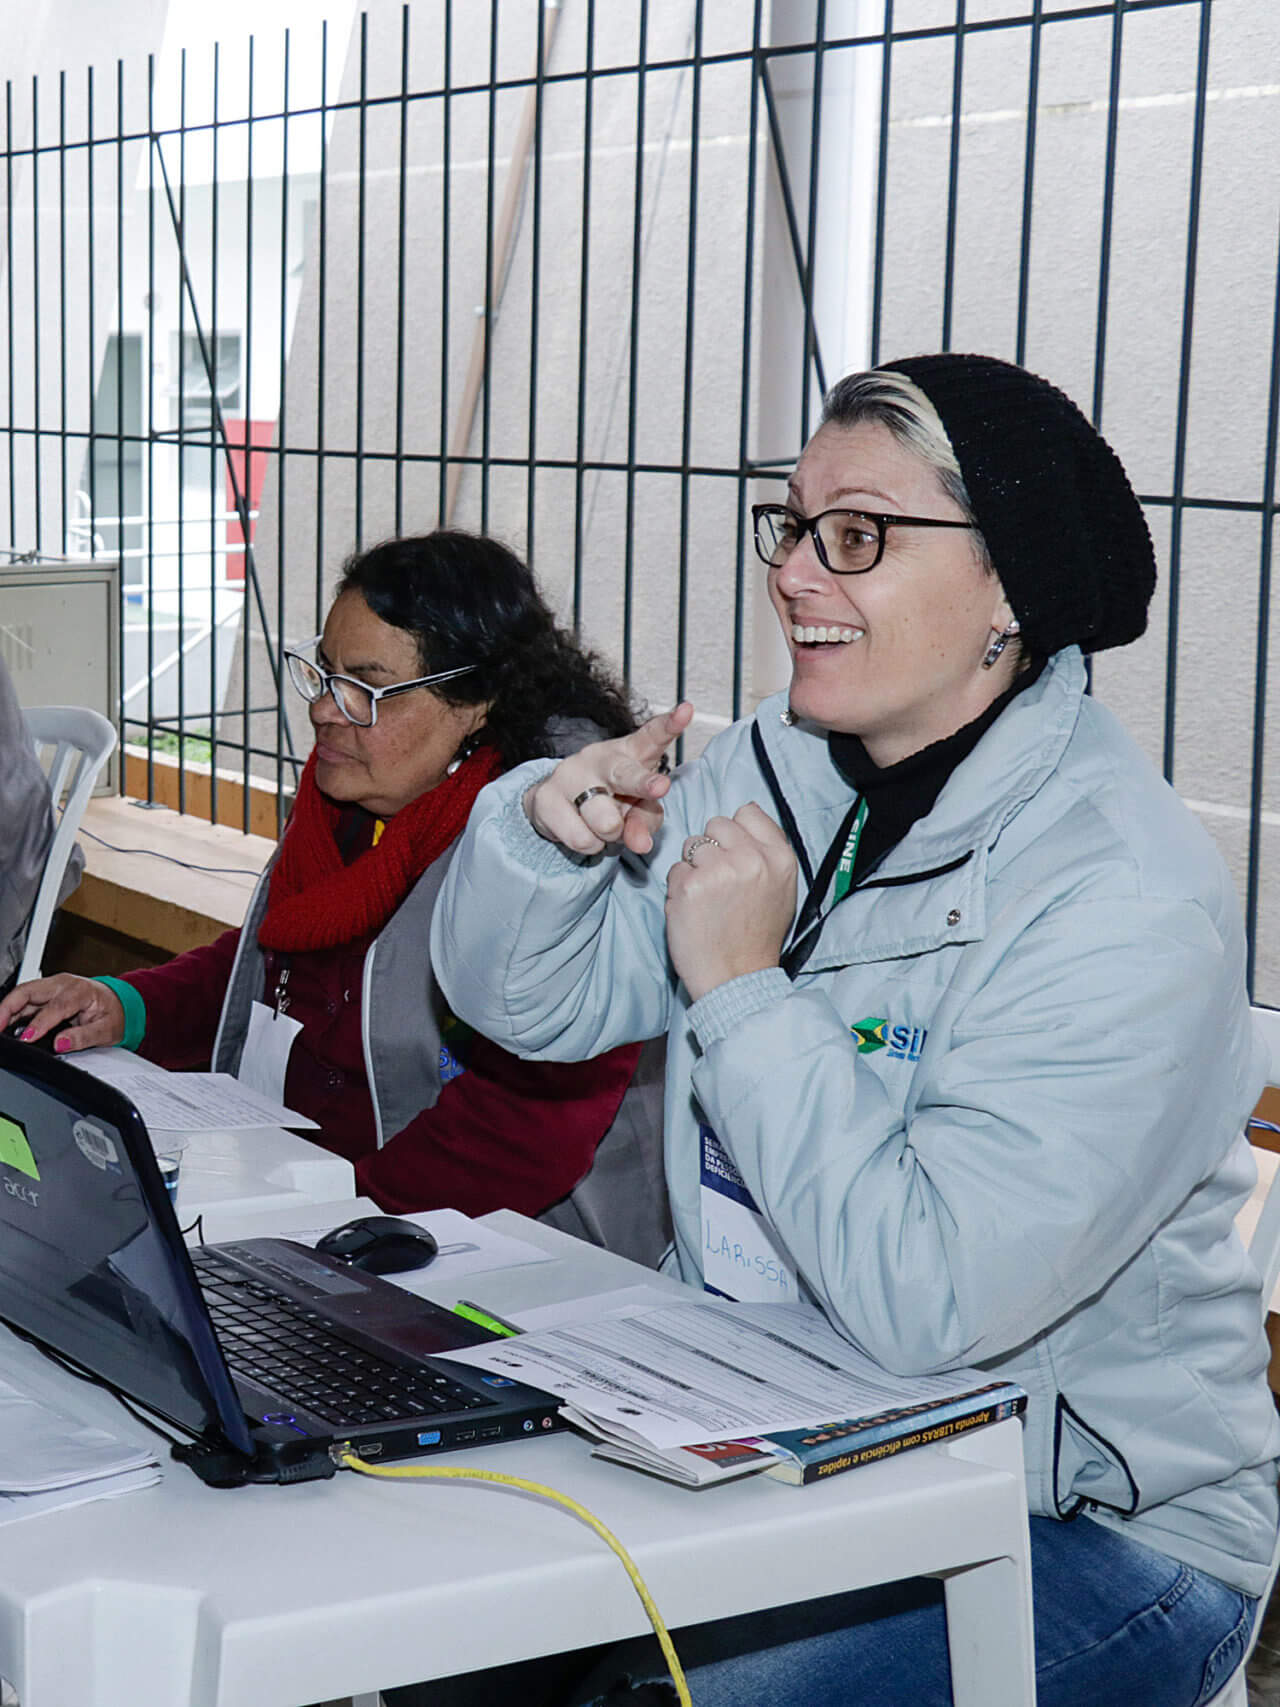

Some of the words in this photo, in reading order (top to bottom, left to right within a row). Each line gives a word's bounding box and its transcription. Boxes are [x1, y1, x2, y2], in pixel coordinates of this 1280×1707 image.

[955, 1411, 990, 1430] Aprenda
[903, 1435, 921, 1449] com
[922, 1424, 954, 1443] LIBRAS
[852, 1454, 859, 1464] e
[860, 1441, 902, 1460] eficiência
[818, 1457, 852, 1475] rapidez
